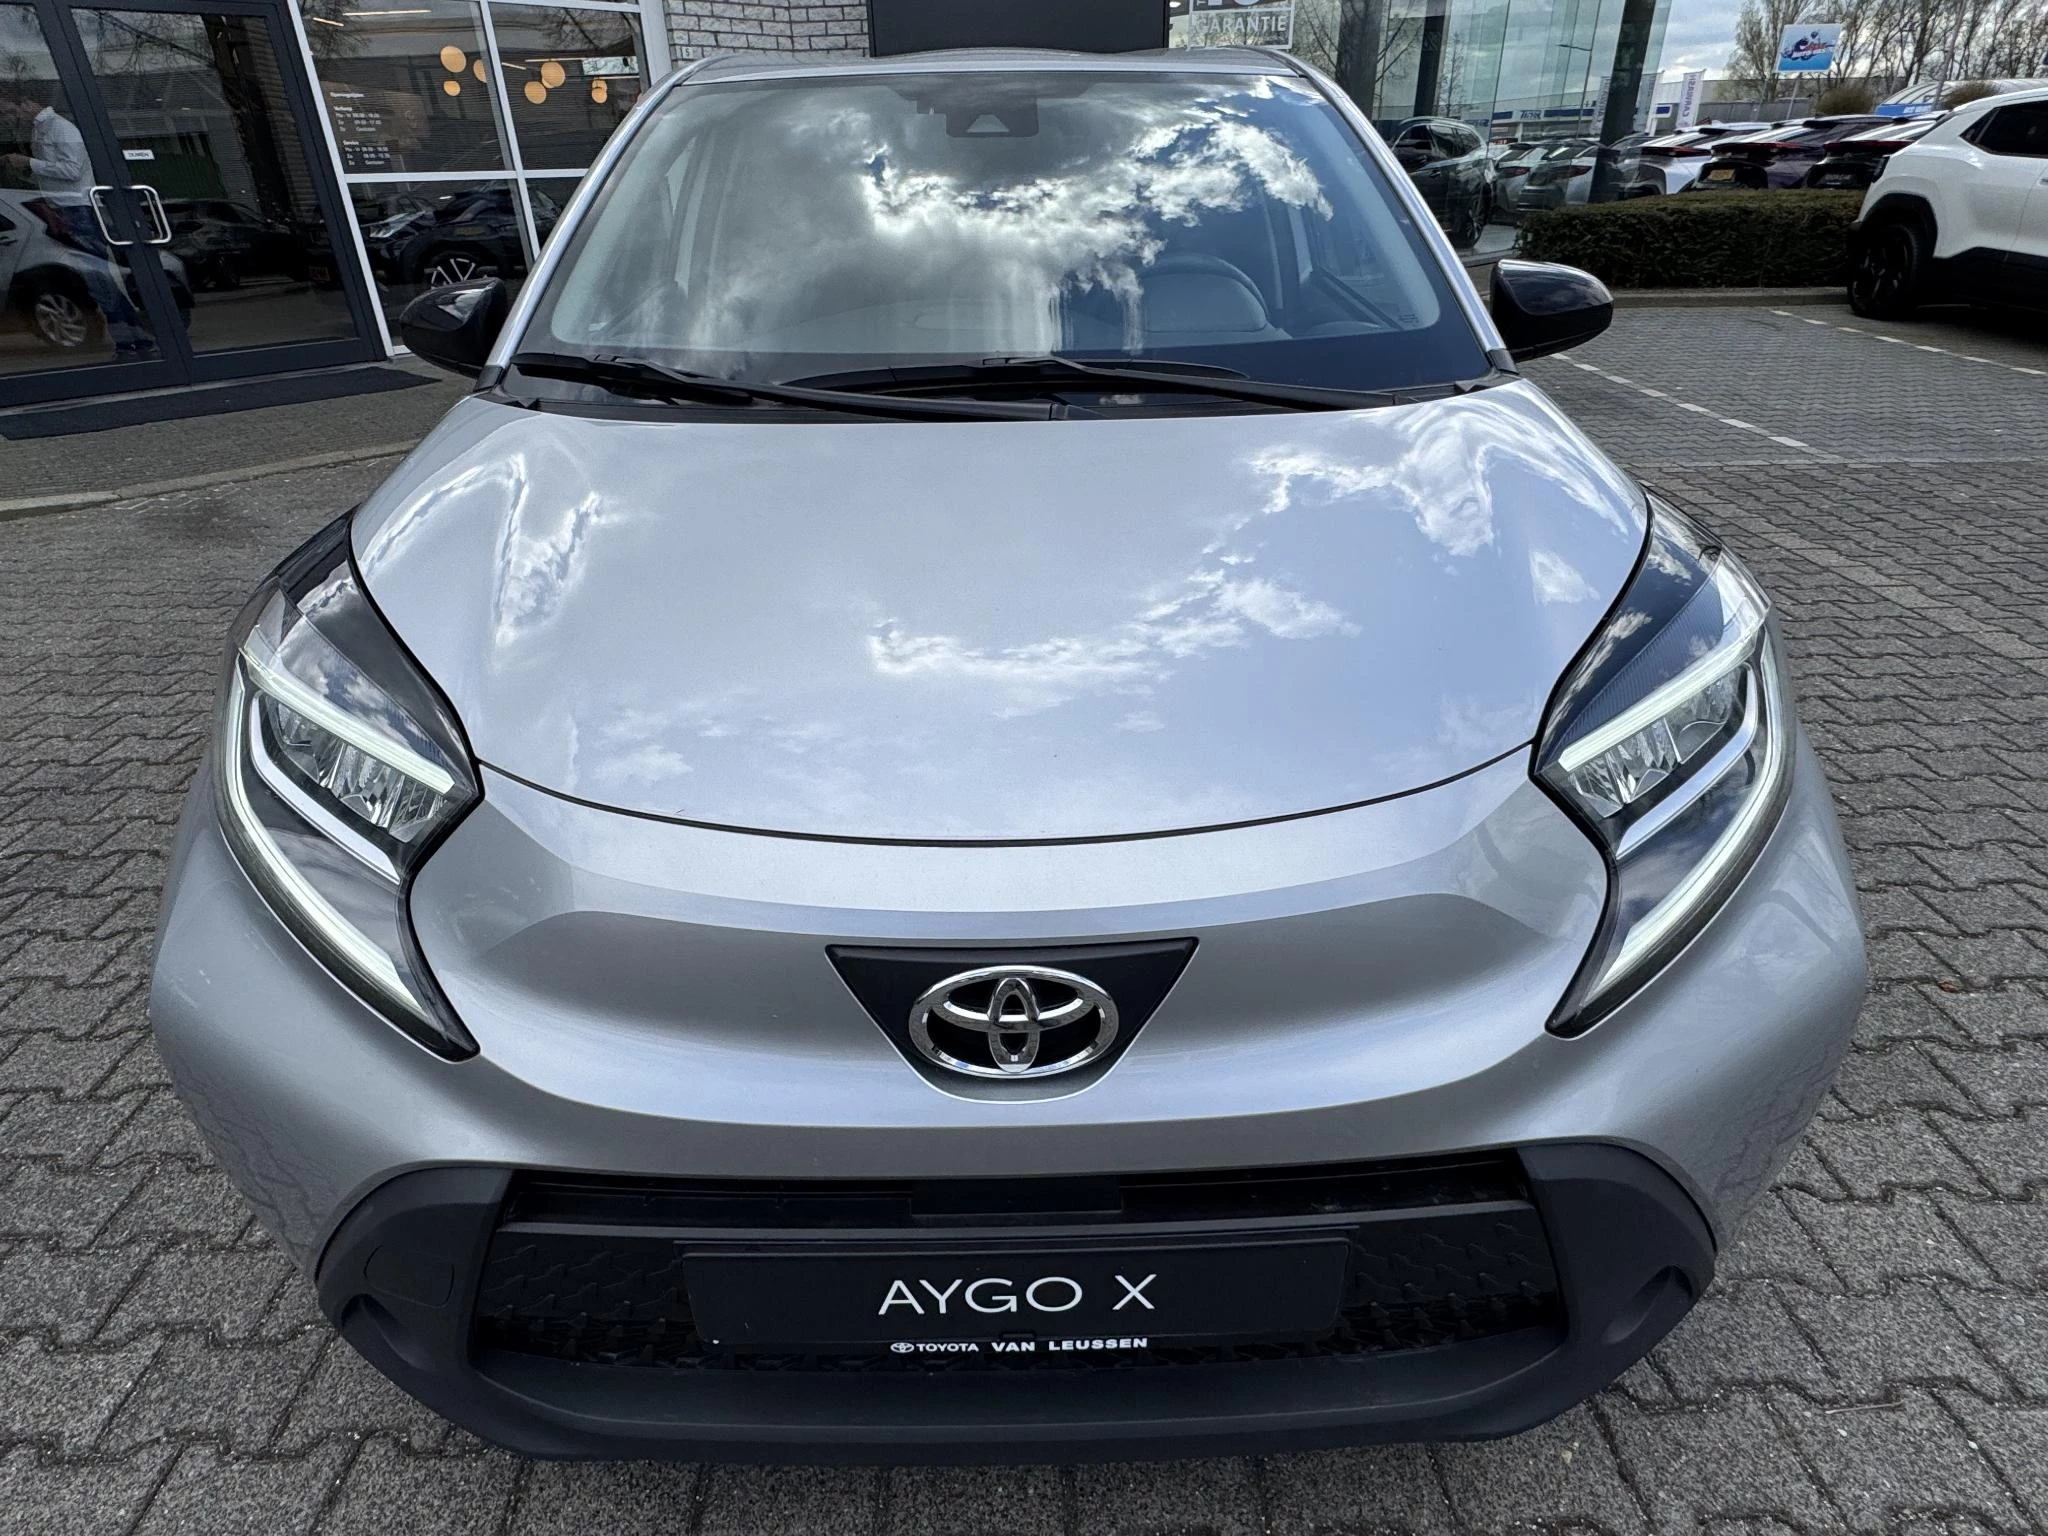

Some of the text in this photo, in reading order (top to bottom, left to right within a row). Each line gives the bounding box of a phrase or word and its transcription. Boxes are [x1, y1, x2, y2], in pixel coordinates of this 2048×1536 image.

[1196, 15, 1287, 33] GARANTIE
[878, 1273, 1157, 1315] AYGO X
[916, 1338, 1148, 1352] TOYOTA VAN LEUSSEN
